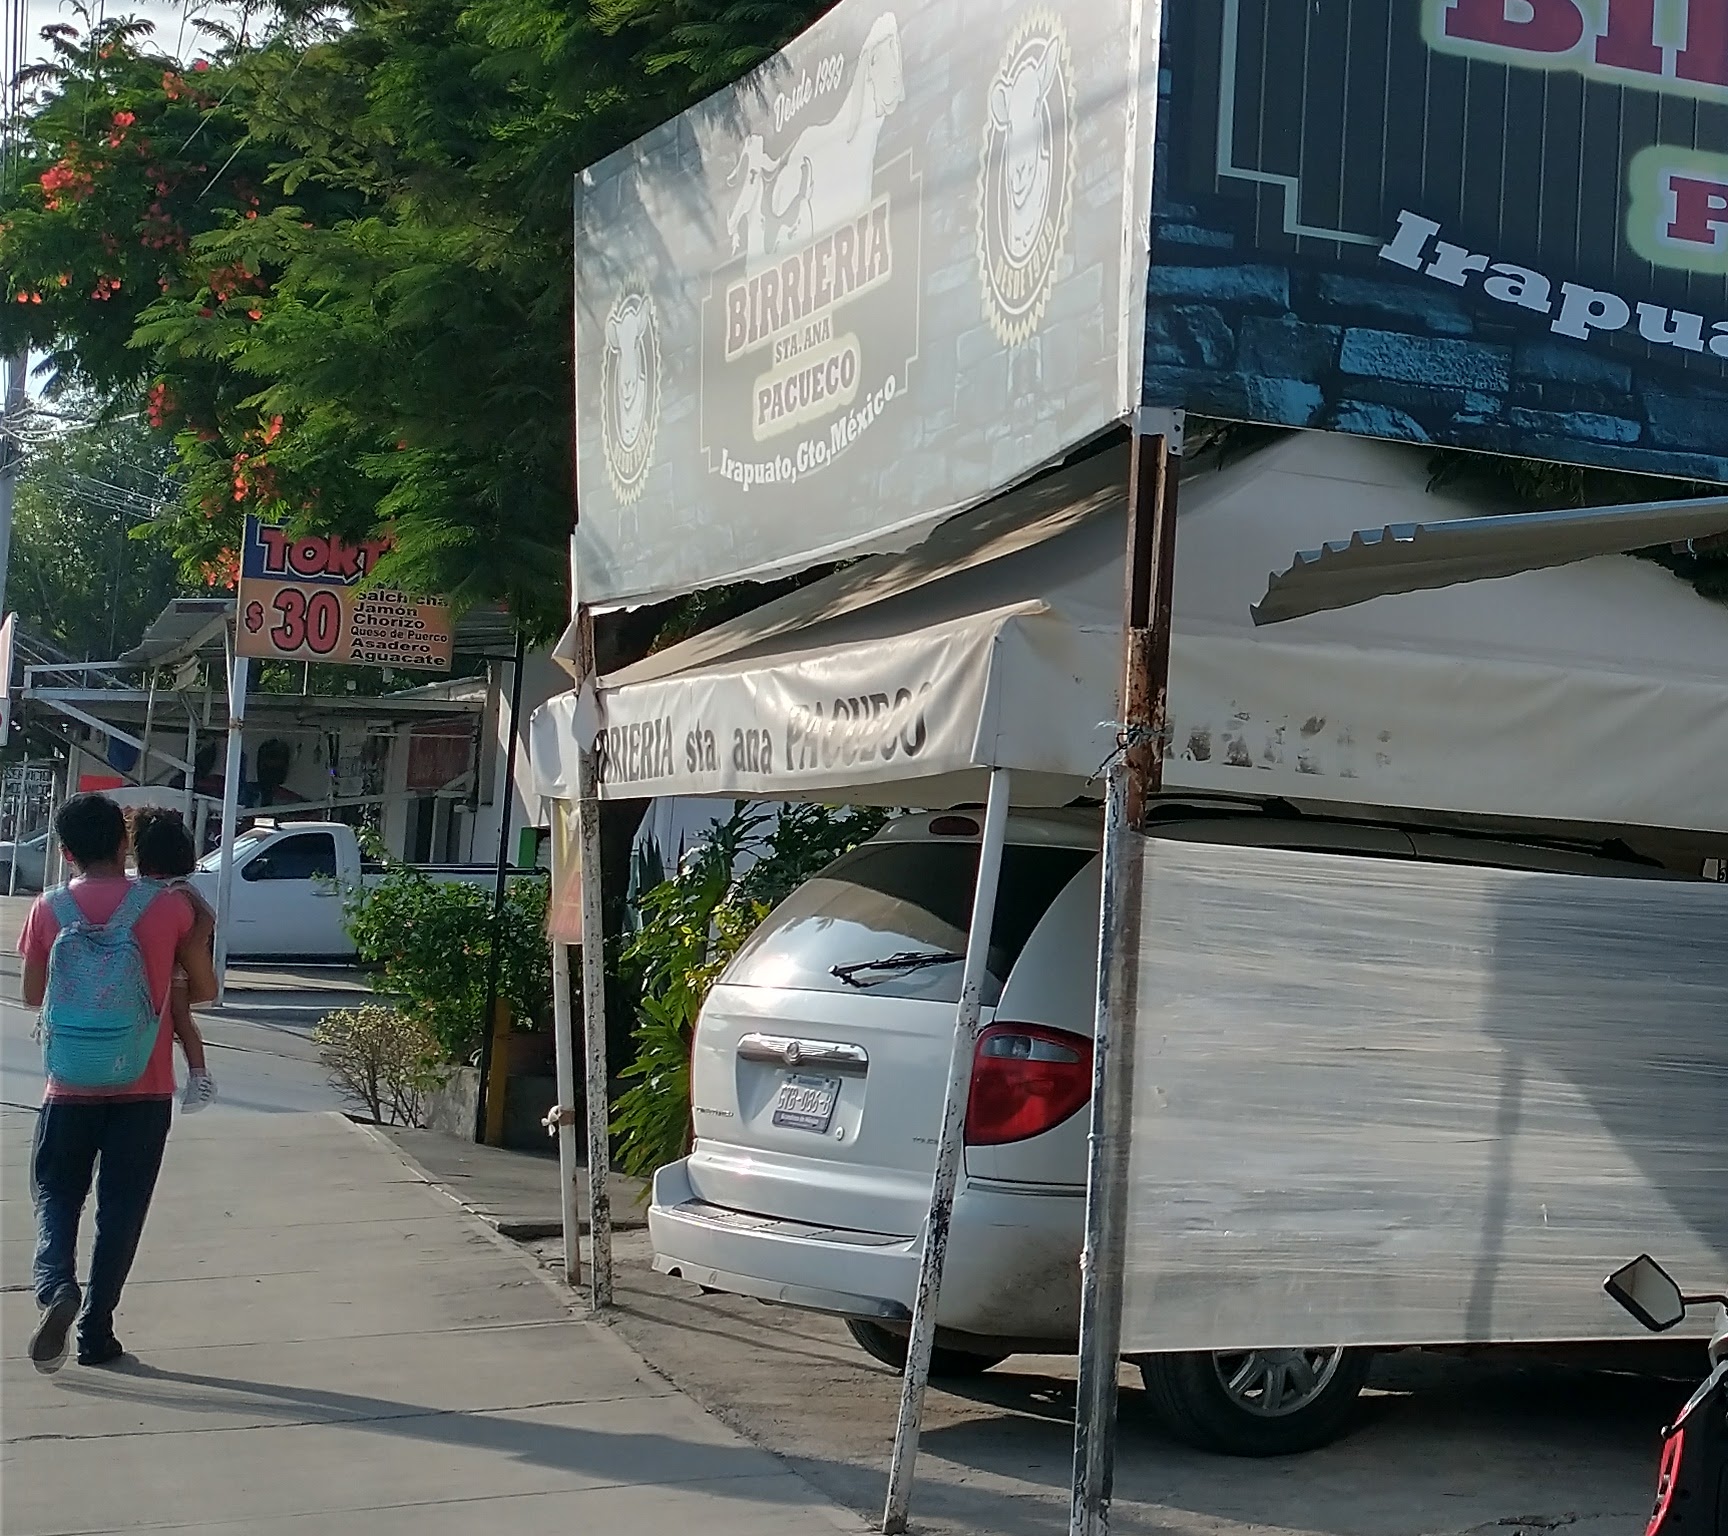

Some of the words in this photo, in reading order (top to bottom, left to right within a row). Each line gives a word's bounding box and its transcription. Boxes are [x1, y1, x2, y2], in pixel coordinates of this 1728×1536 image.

[774, 68, 812, 133] Desde
[814, 52, 845, 98] 1999
[727, 201, 889, 355] BIRRIERIA
[803, 316, 831, 351] ANA
[758, 348, 856, 426] PACUECO
[260, 526, 392, 581] TORT
[270, 587, 342, 655] 30
[353, 602, 418, 617] Jamón
[353, 613, 426, 630] Chorizo
[350, 626, 387, 638] Queso
[390, 628, 404, 640] de
[407, 630, 448, 643] Puerco
[350, 648, 446, 666] Aguacate
[351, 637, 431, 653] Asadero
[732, 727, 774, 775] ana
[785, 681, 933, 772] PACUECO
